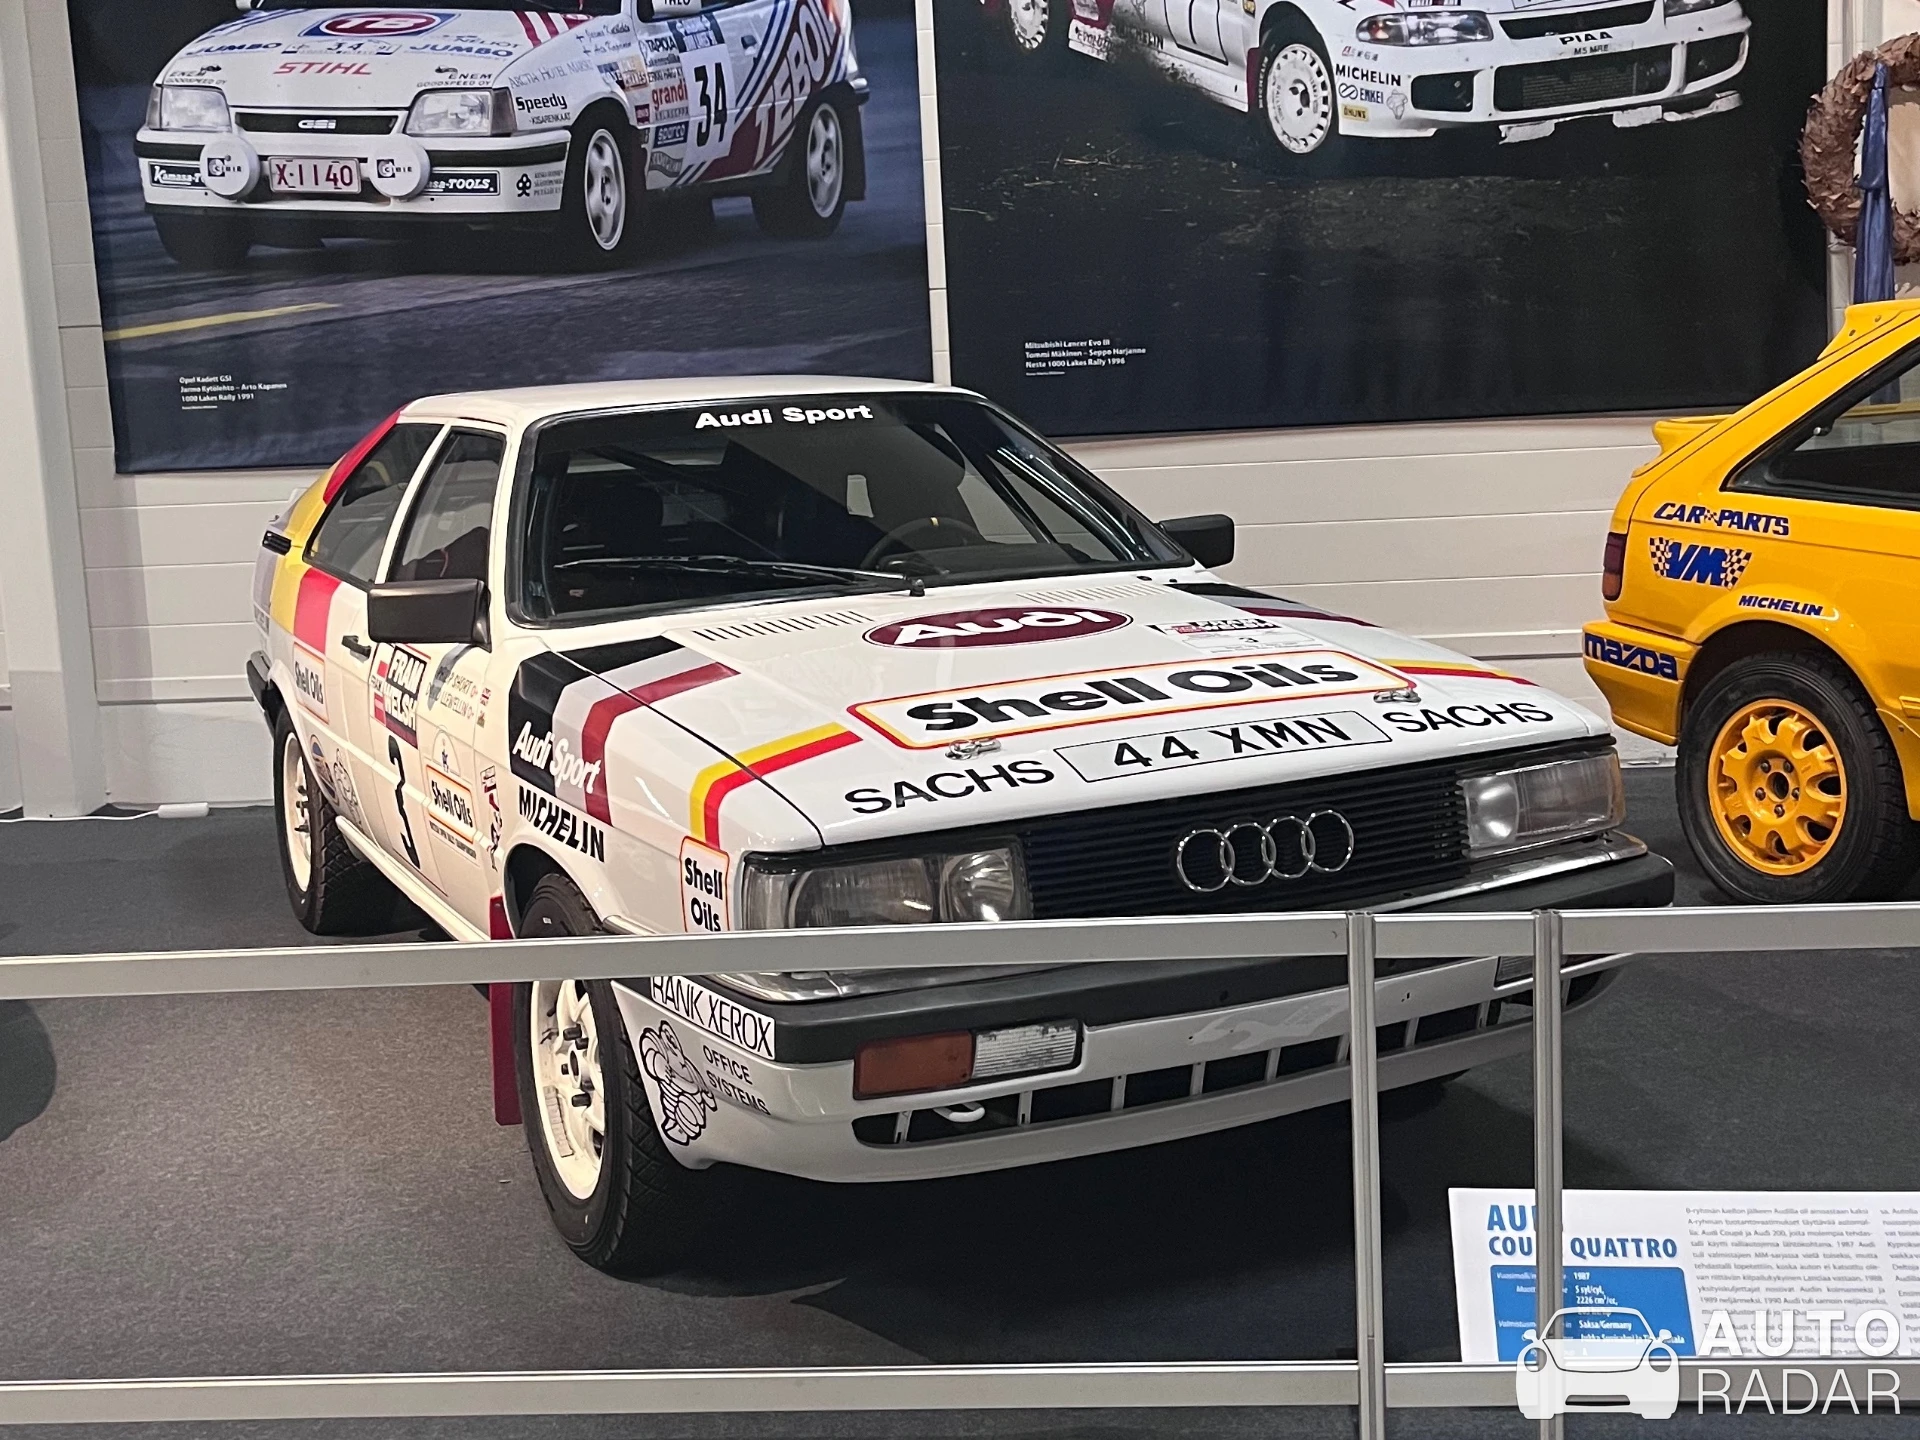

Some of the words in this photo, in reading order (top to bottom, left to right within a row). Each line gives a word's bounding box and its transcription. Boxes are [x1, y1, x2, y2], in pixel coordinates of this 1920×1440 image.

[409, 44, 514, 57] JUMBO
[1558, 31, 1613, 46] PIAA
[273, 62, 372, 76] STIHL
[1335, 63, 1402, 87] MICHELIN
[515, 93, 568, 114] Speedy
[652, 79, 688, 110] grandi
[694, 62, 728, 148] 34
[657, 124, 686, 141] sparco
[1024, 340, 1063, 349] Mitsubishi
[1063, 340, 1087, 348] Lancer
[1088, 339, 1102, 347] Evo
[1025, 351, 1050, 359] Tommi
[1088, 348, 1112, 357] Seppo
[1112, 348, 1146, 356] Harjanne
[1066, 359, 1087, 367] Lakes
[1087, 358, 1106, 367] Rally
[179, 376, 196, 384] Opel
[196, 375, 219, 383] Kadett
[241, 383, 257, 391] Arto
[257, 383, 288, 391] Kapanen
[199, 394, 218, 402] Lakes
[218, 393, 236, 402] Rally
[237, 392, 254, 400] 1991
[694, 408, 773, 429] Audi
[781, 405, 874, 424] Sport
[1653, 502, 1706, 523] CAR
[1715, 508, 1790, 537] PARTS
[1665, 541, 1729, 588] VM
[1738, 594, 1824, 617] MICHELIN
[893, 609, 1113, 646] Audi
[387, 648, 427, 695] FRAM
[1584, 632, 1679, 681] mazda
[906, 676, 1172, 731] Shell
[1166, 662, 1360, 696] Oils
[512, 720, 556, 770] Audi
[550, 738, 602, 794] Sport
[844, 758, 1055, 814] SACHS
[1113, 735, 1200, 769] 44
[1213, 717, 1352, 754] XMN
[1381, 702, 1554, 734] SACHS
[388, 734, 421, 870] 3
[431, 779, 455, 818] Shell
[453, 792, 474, 829] Oils
[519, 784, 605, 863] MICHELIN
[684, 857, 723, 901] Shell
[690, 896, 722, 932] Oils
[708, 994, 773, 1059] XEROX
[703, 1044, 754, 1086] OFFICE
[706, 1069, 771, 1116] SYSTEMS
[1569, 1237, 1678, 1260] QUATTRO
[1576, 1296, 1594, 1305] 2226
